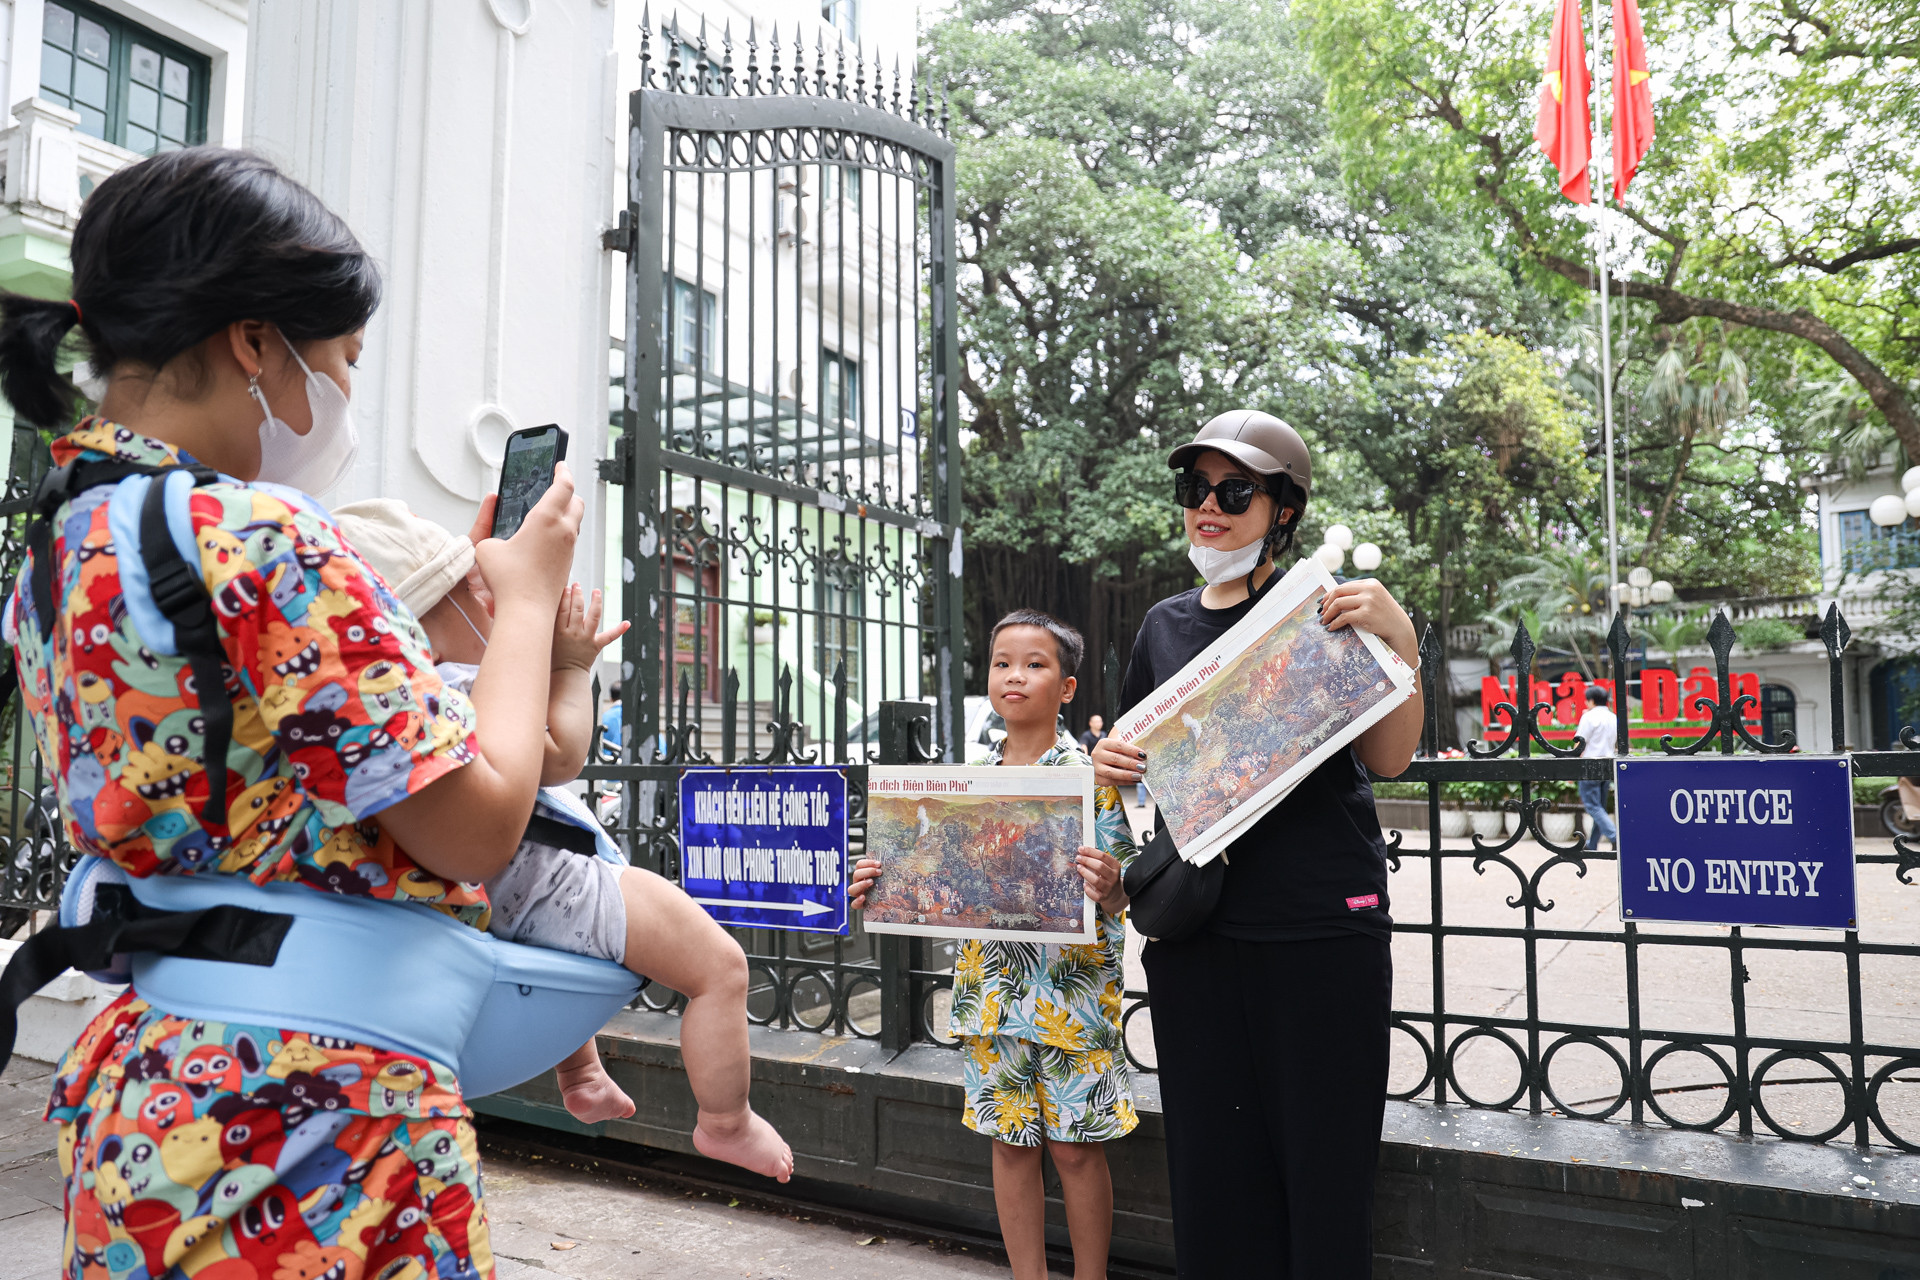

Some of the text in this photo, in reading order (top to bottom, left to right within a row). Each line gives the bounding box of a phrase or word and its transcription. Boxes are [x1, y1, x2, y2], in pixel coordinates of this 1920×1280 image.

[1133, 713, 1155, 735] dịch
[1154, 695, 1178, 716] Điện
[1176, 677, 1200, 698] Biên
[1640, 667, 1762, 723] Dân
[694, 779, 830, 831] KHÁCH ĐẾN LIÊN HỆ CÔNG TÁC
[880, 779, 900, 792] dịch
[903, 779, 924, 793] Điện
[926, 779, 947, 791] Biên
[1670, 788, 1793, 825] OFFICE
[687, 837, 840, 894] XIN MỜI QUA PHÒNG THƯỜNG TRỰC
[1646, 857, 1824, 897] NO ENTRY
